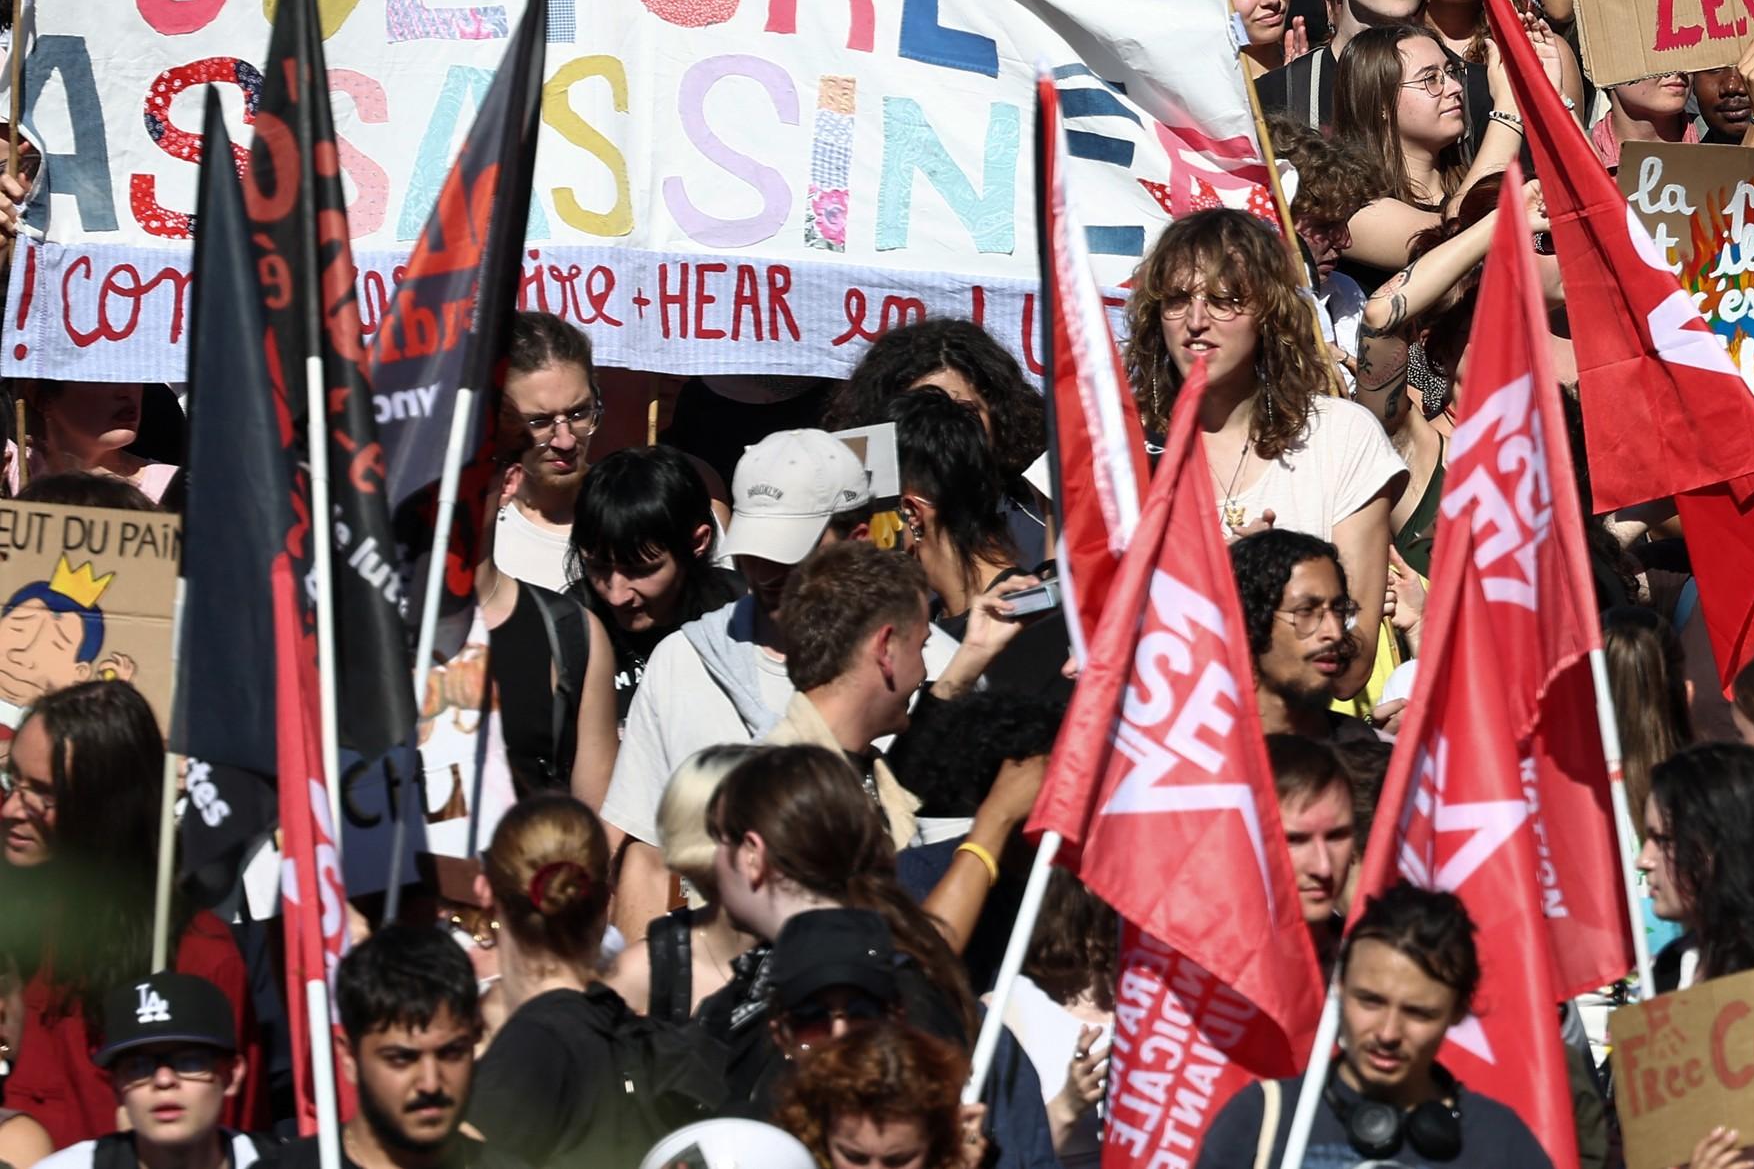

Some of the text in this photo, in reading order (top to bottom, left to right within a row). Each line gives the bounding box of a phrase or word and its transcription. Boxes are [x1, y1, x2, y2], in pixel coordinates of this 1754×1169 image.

[1627, 156, 1697, 216] la
[1652, 222, 1684, 276] t
[63, 516, 109, 554] DU
